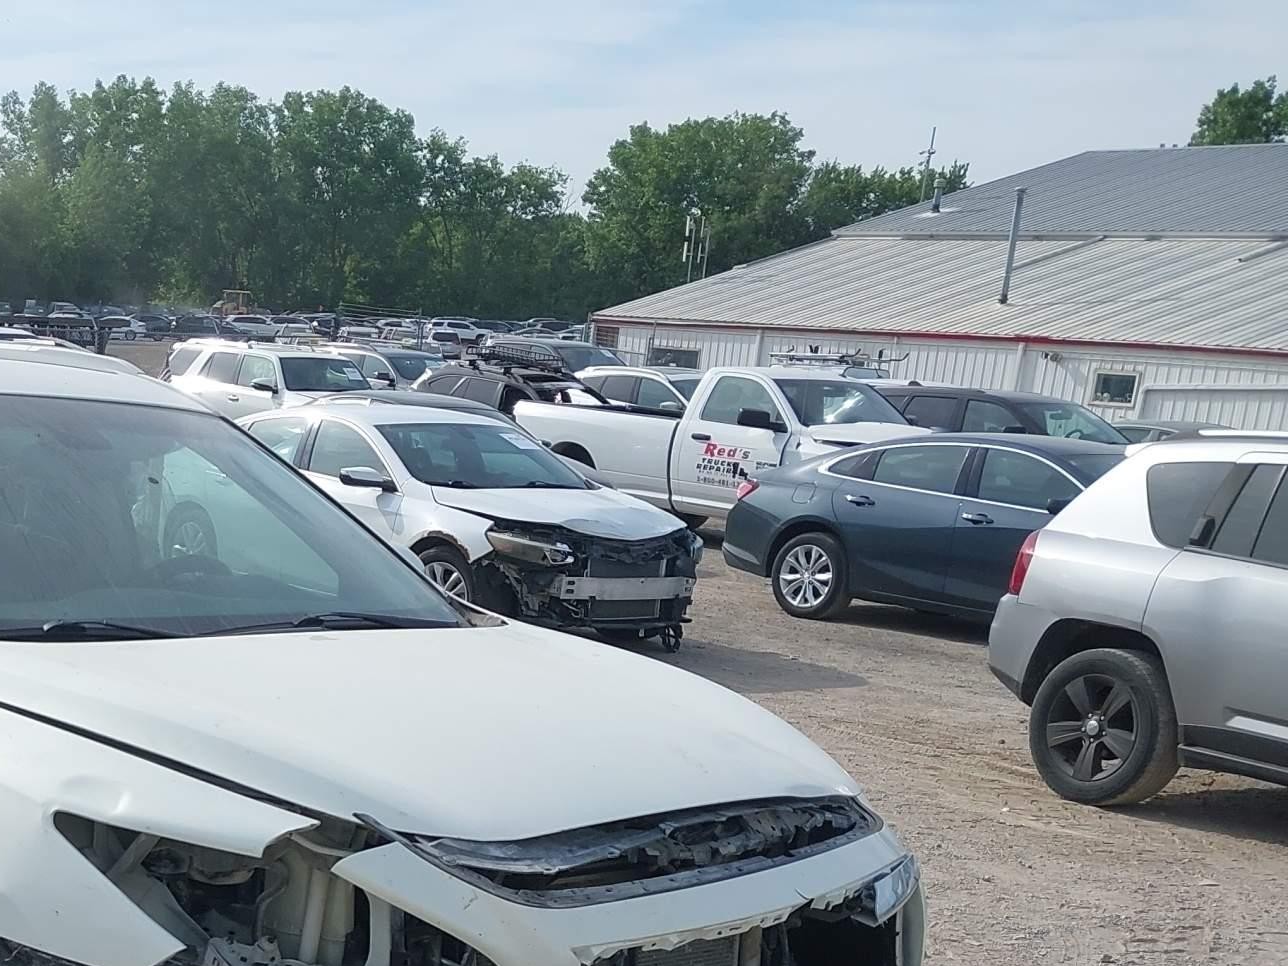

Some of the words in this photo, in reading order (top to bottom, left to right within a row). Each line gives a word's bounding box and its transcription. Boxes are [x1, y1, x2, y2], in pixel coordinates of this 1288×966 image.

[704, 442, 751, 459] Red's
[701, 457, 733, 467] TRUCK
[696, 463, 733, 474] REPAIR
